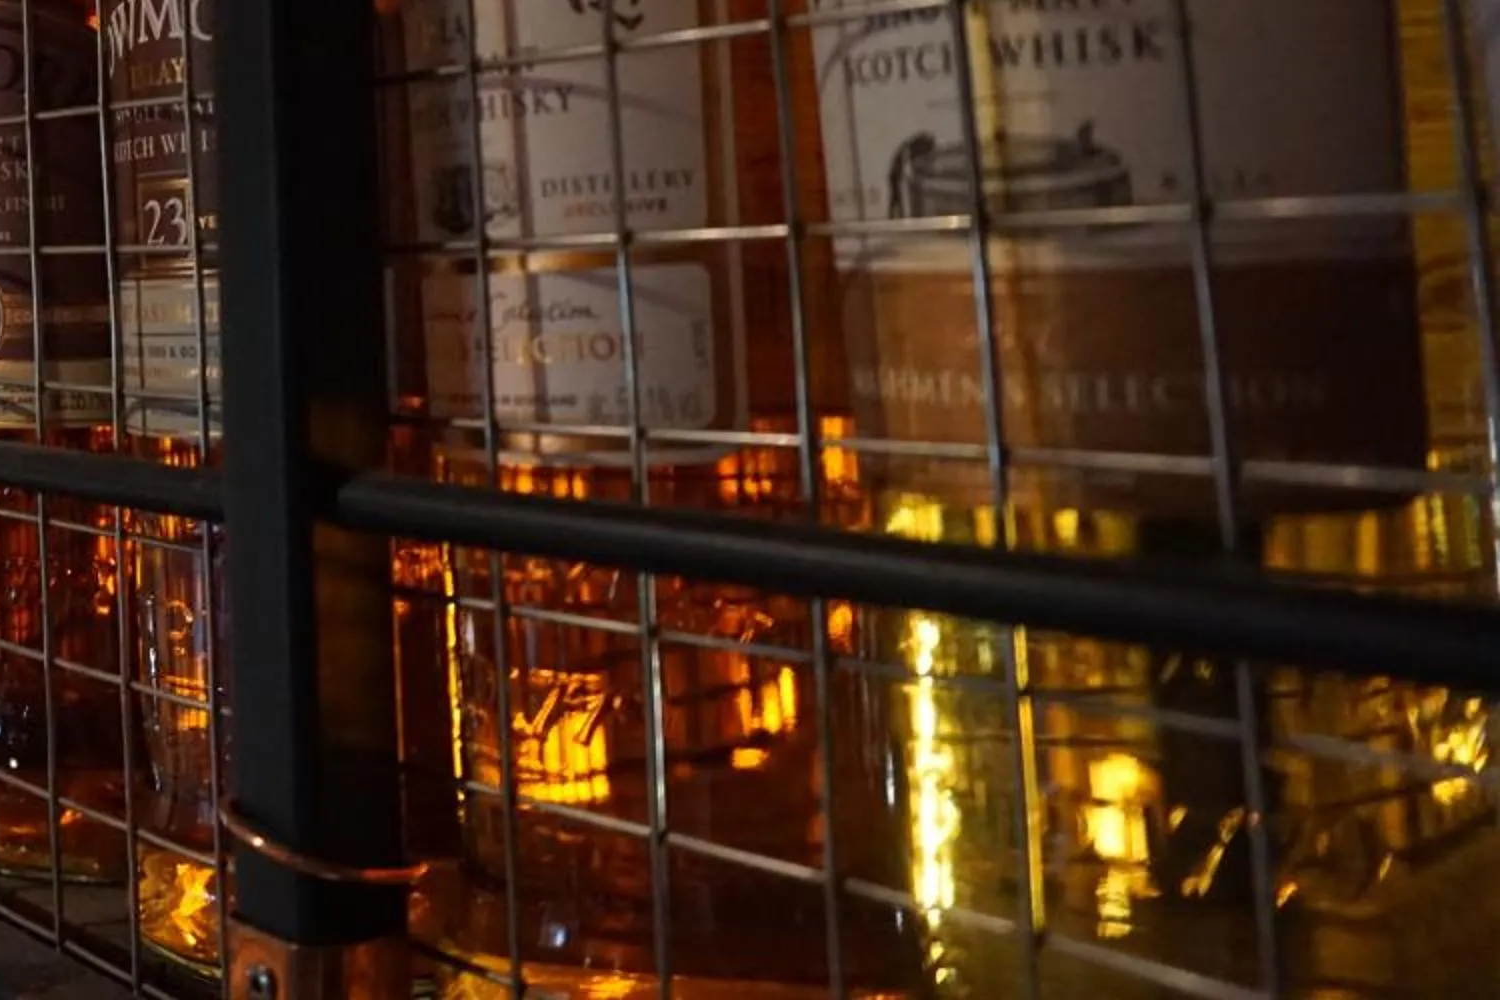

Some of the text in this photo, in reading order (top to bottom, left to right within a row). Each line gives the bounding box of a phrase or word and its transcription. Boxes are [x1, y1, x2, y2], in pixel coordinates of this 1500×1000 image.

[992, 22, 1166, 70] WHISK
[540, 167, 696, 199] DISTILERY
[144, 196, 187, 247] 23
[563, 197, 668, 219] EXCLSIVE
